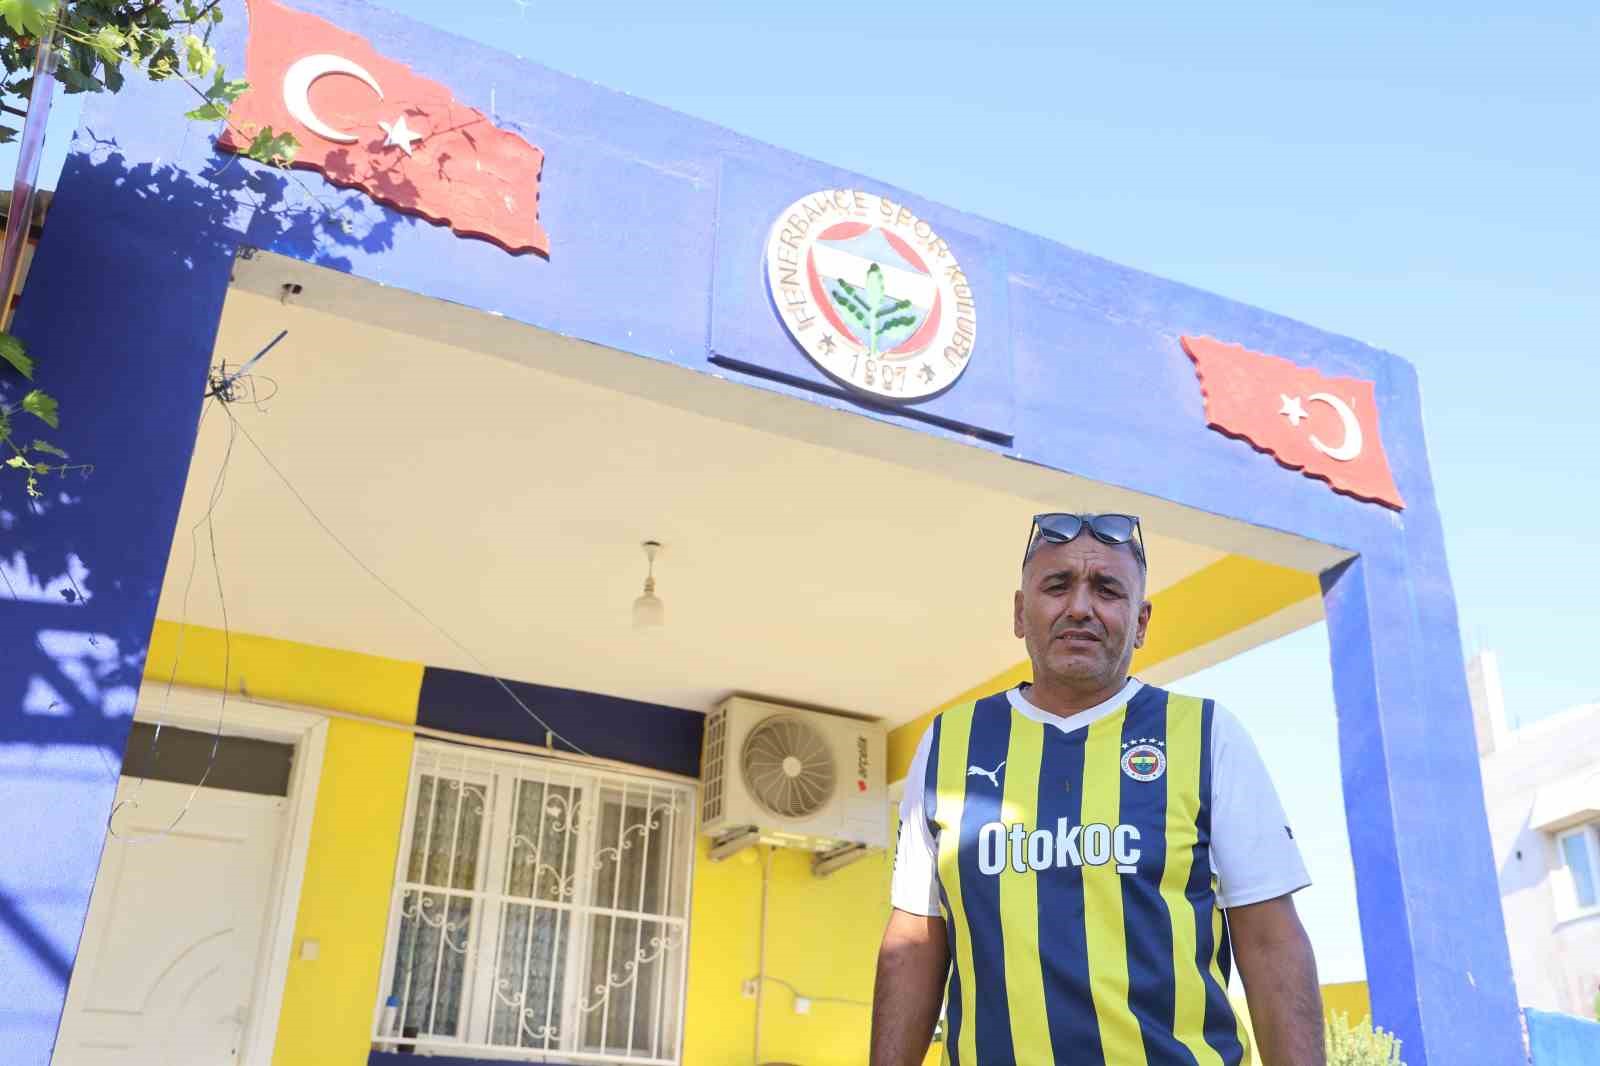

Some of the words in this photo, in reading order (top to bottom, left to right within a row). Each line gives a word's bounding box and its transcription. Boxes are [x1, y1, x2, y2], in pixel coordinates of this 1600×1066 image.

[778, 187, 868, 331] FENERBAHÇE
[880, 196, 950, 259] SPOR
[851, 353, 907, 392] 1907
[978, 816, 1141, 875] Otokoç
